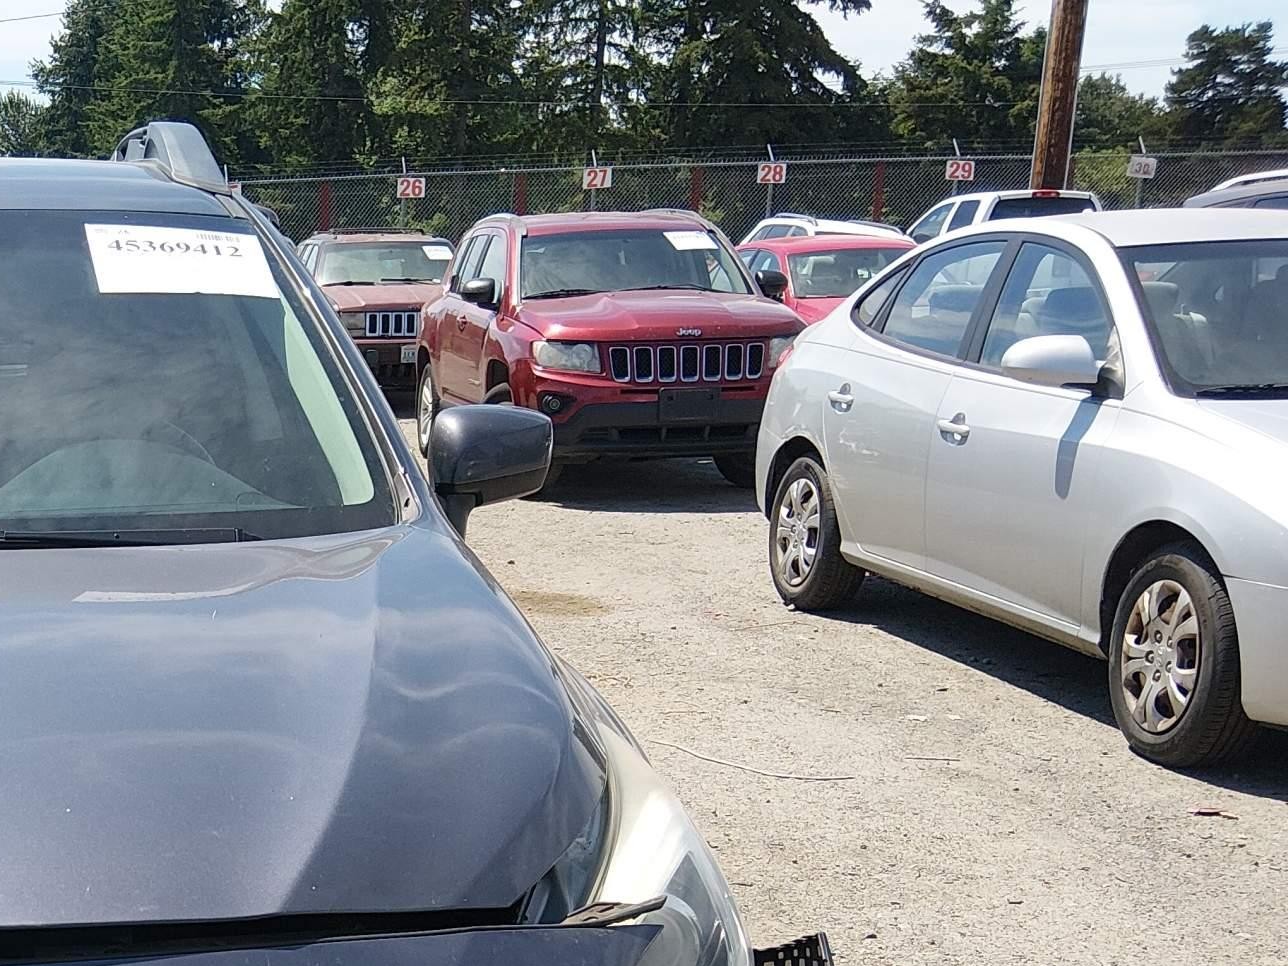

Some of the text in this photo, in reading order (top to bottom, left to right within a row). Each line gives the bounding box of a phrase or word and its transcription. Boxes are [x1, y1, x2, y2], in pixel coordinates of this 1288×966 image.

[760, 164, 783, 182] 28
[948, 161, 972, 179] 29
[1135, 161, 1150, 174] 30
[587, 169, 608, 187] 27
[399, 179, 423, 197] 26
[107, 239, 243, 257] 45369412
[675, 327, 702, 337] Jeep
